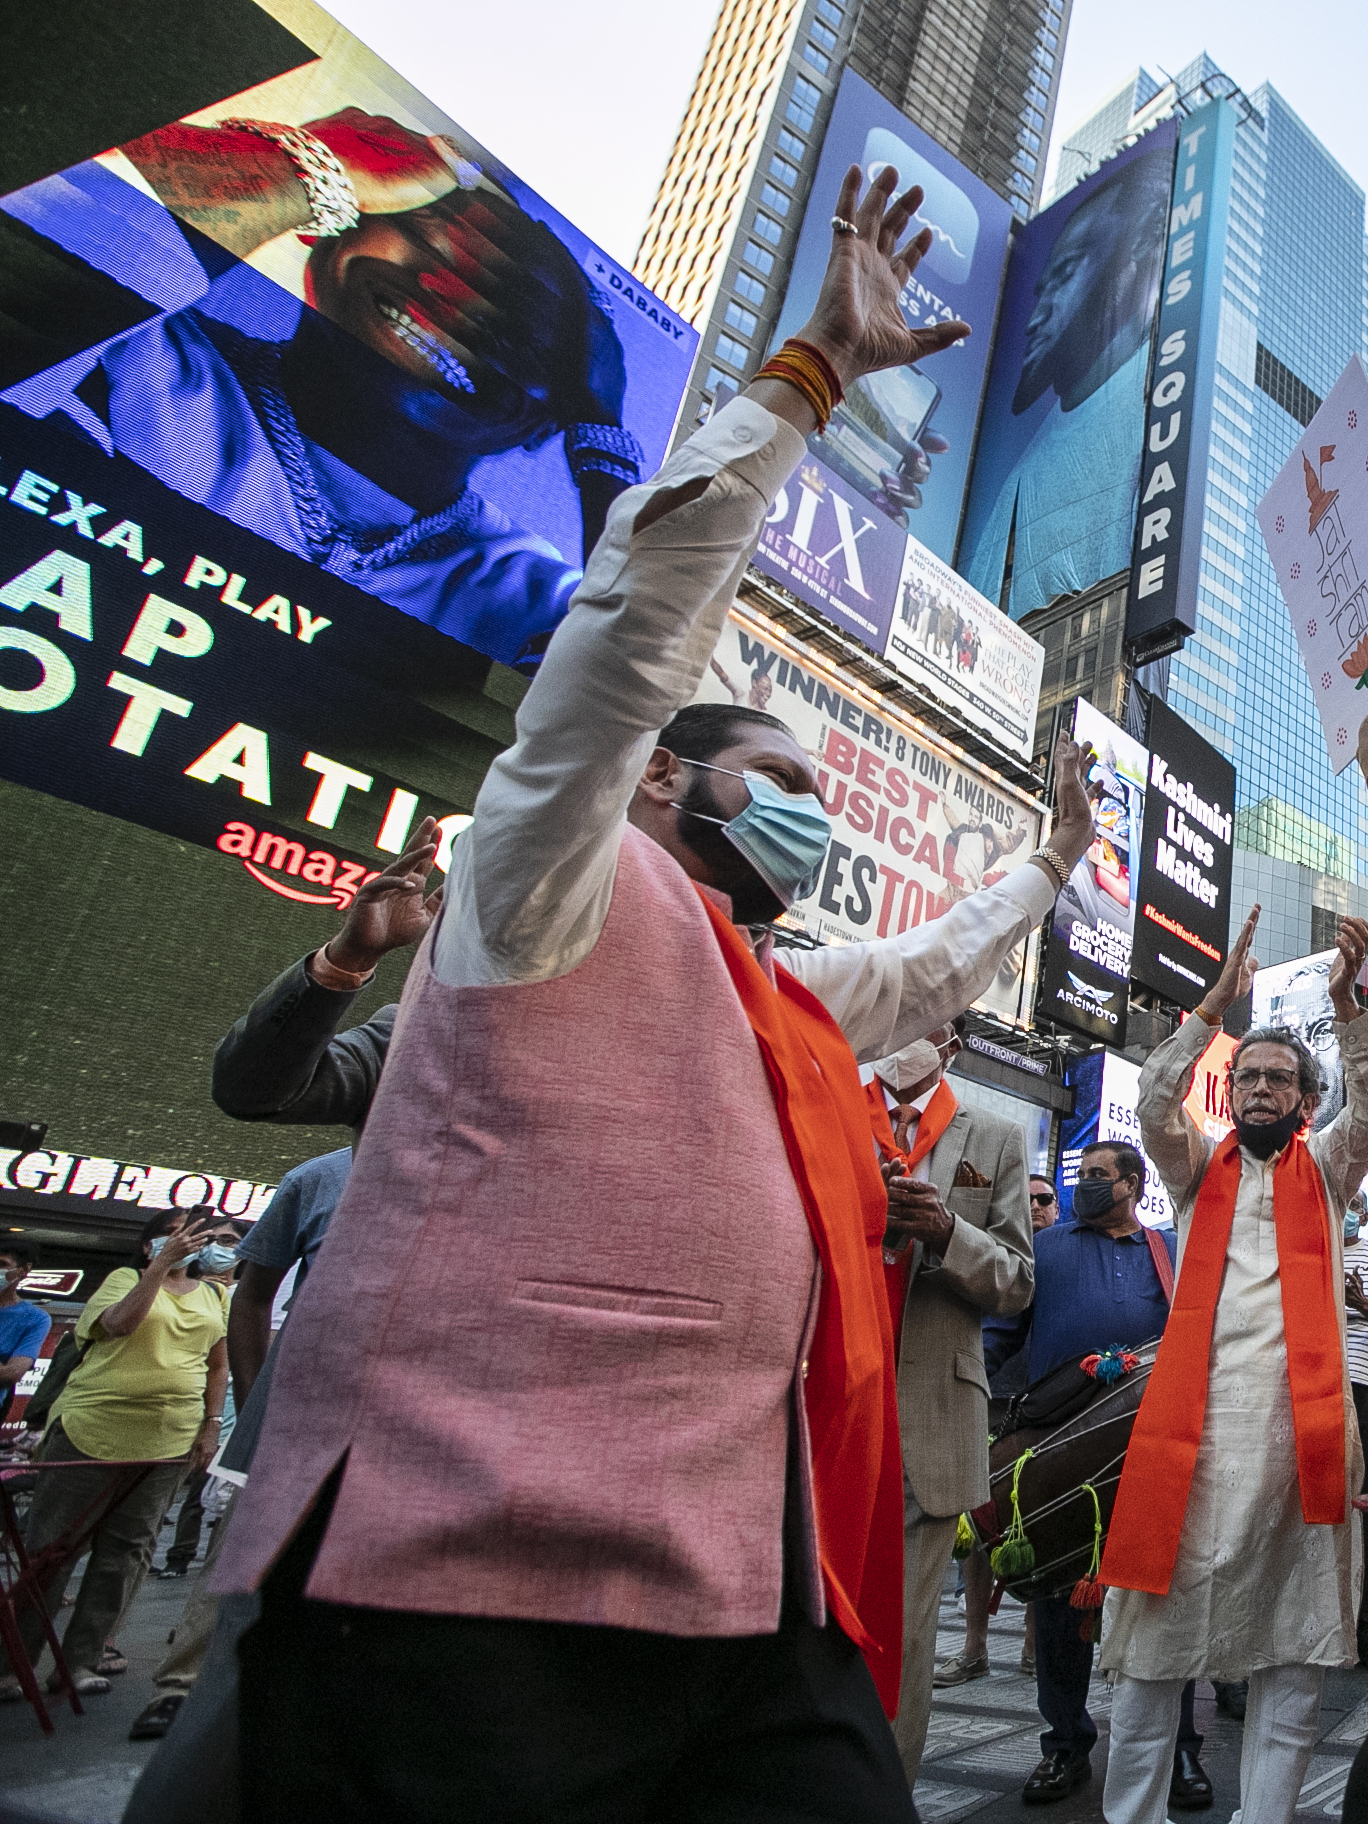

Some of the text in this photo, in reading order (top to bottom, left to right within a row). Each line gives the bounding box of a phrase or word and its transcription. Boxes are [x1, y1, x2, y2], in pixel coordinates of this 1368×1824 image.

[609, 273, 684, 341] DABABY
[1137, 126, 1207, 600] TIMES SQUARE
[764, 526, 843, 597] HE MUSICAL
[0, 549, 215, 667] AP
[182, 554, 331, 645] PLAY
[908, 555, 1037, 663] AND INTERNATIONAL PHENOMENON
[914, 548, 1035, 653] BROADWAY'S FUNNIEST SMASH HIT
[737, 629, 893, 753] WINNER!
[906, 648, 922, 664] NEW
[923, 658, 947, 682] WORLD
[947, 674, 970, 699] STAGES
[1004, 718, 1025, 741] STREET
[981, 659, 1034, 714] WRONG
[1006, 649, 1033, 679] PLAY
[1006, 665, 1036, 697] GOES
[0, 626, 474, 874] OTATI
[824, 726, 939, 824] BEST
[896, 734, 1015, 831] 8 TONY AWARDS
[812, 764, 965, 887] USICAL
[1151, 753, 1232, 845] Kashmiri
[216, 822, 381, 895] amaz
[1165, 805, 1215, 868] Lives
[1156, 837, 1219, 909] Matter
[1068, 934, 1131, 979] DELIVERY
[1071, 920, 1132, 963] GROCERY
[1097, 917, 1132, 949] HOME
[1143, 904, 1222, 962] #KashmirWantsFreedom
[1056, 988, 1118, 1025] ARCIMOTO
[971, 1038, 1045, 1074] OUTFRONT PRIME
[1108, 1102, 1138, 1129] ESSE
[0, 1150, 151, 1202] GLE
[1062, 1149, 1083, 1159] ESSEN
[1140, 1194, 1165, 1215] OES
[17, 1273, 62, 1289] gate
